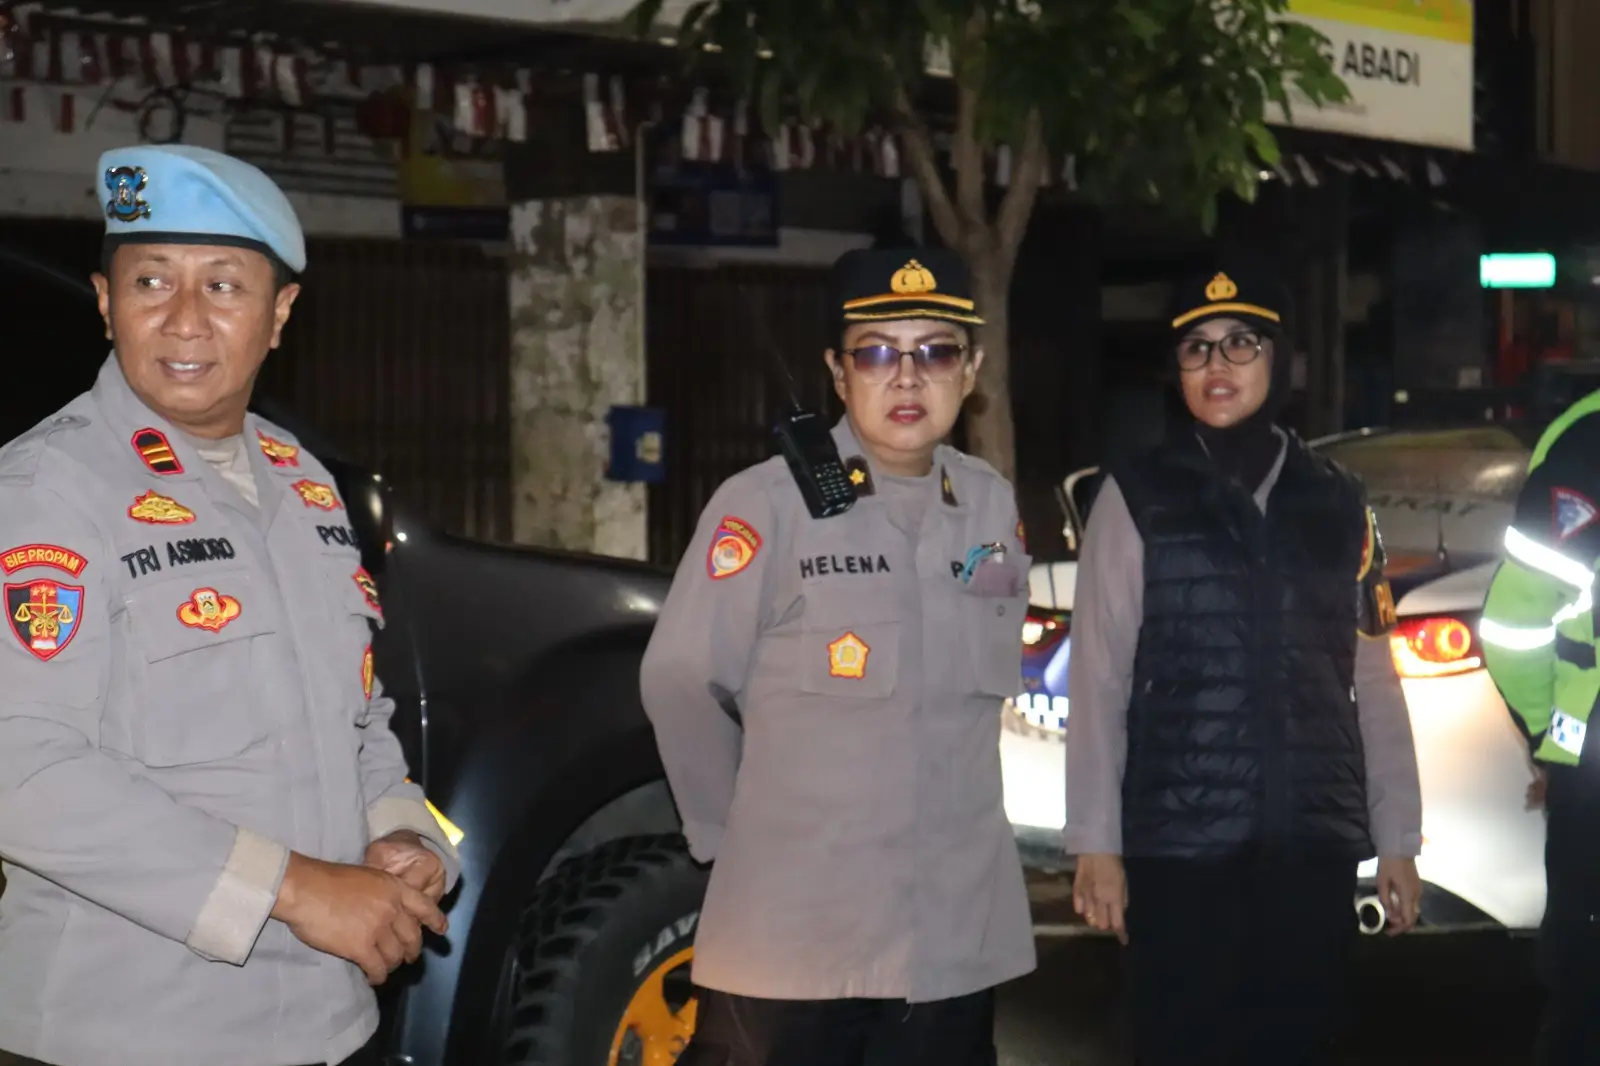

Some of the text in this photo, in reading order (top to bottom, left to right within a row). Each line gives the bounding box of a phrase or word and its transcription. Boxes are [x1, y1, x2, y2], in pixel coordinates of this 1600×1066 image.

[1341, 39, 1420, 88] ABADI
[4, 548, 79, 572] SIE PROPAM
[120, 545, 161, 579] TRI
[799, 553, 890, 579] HELENA
